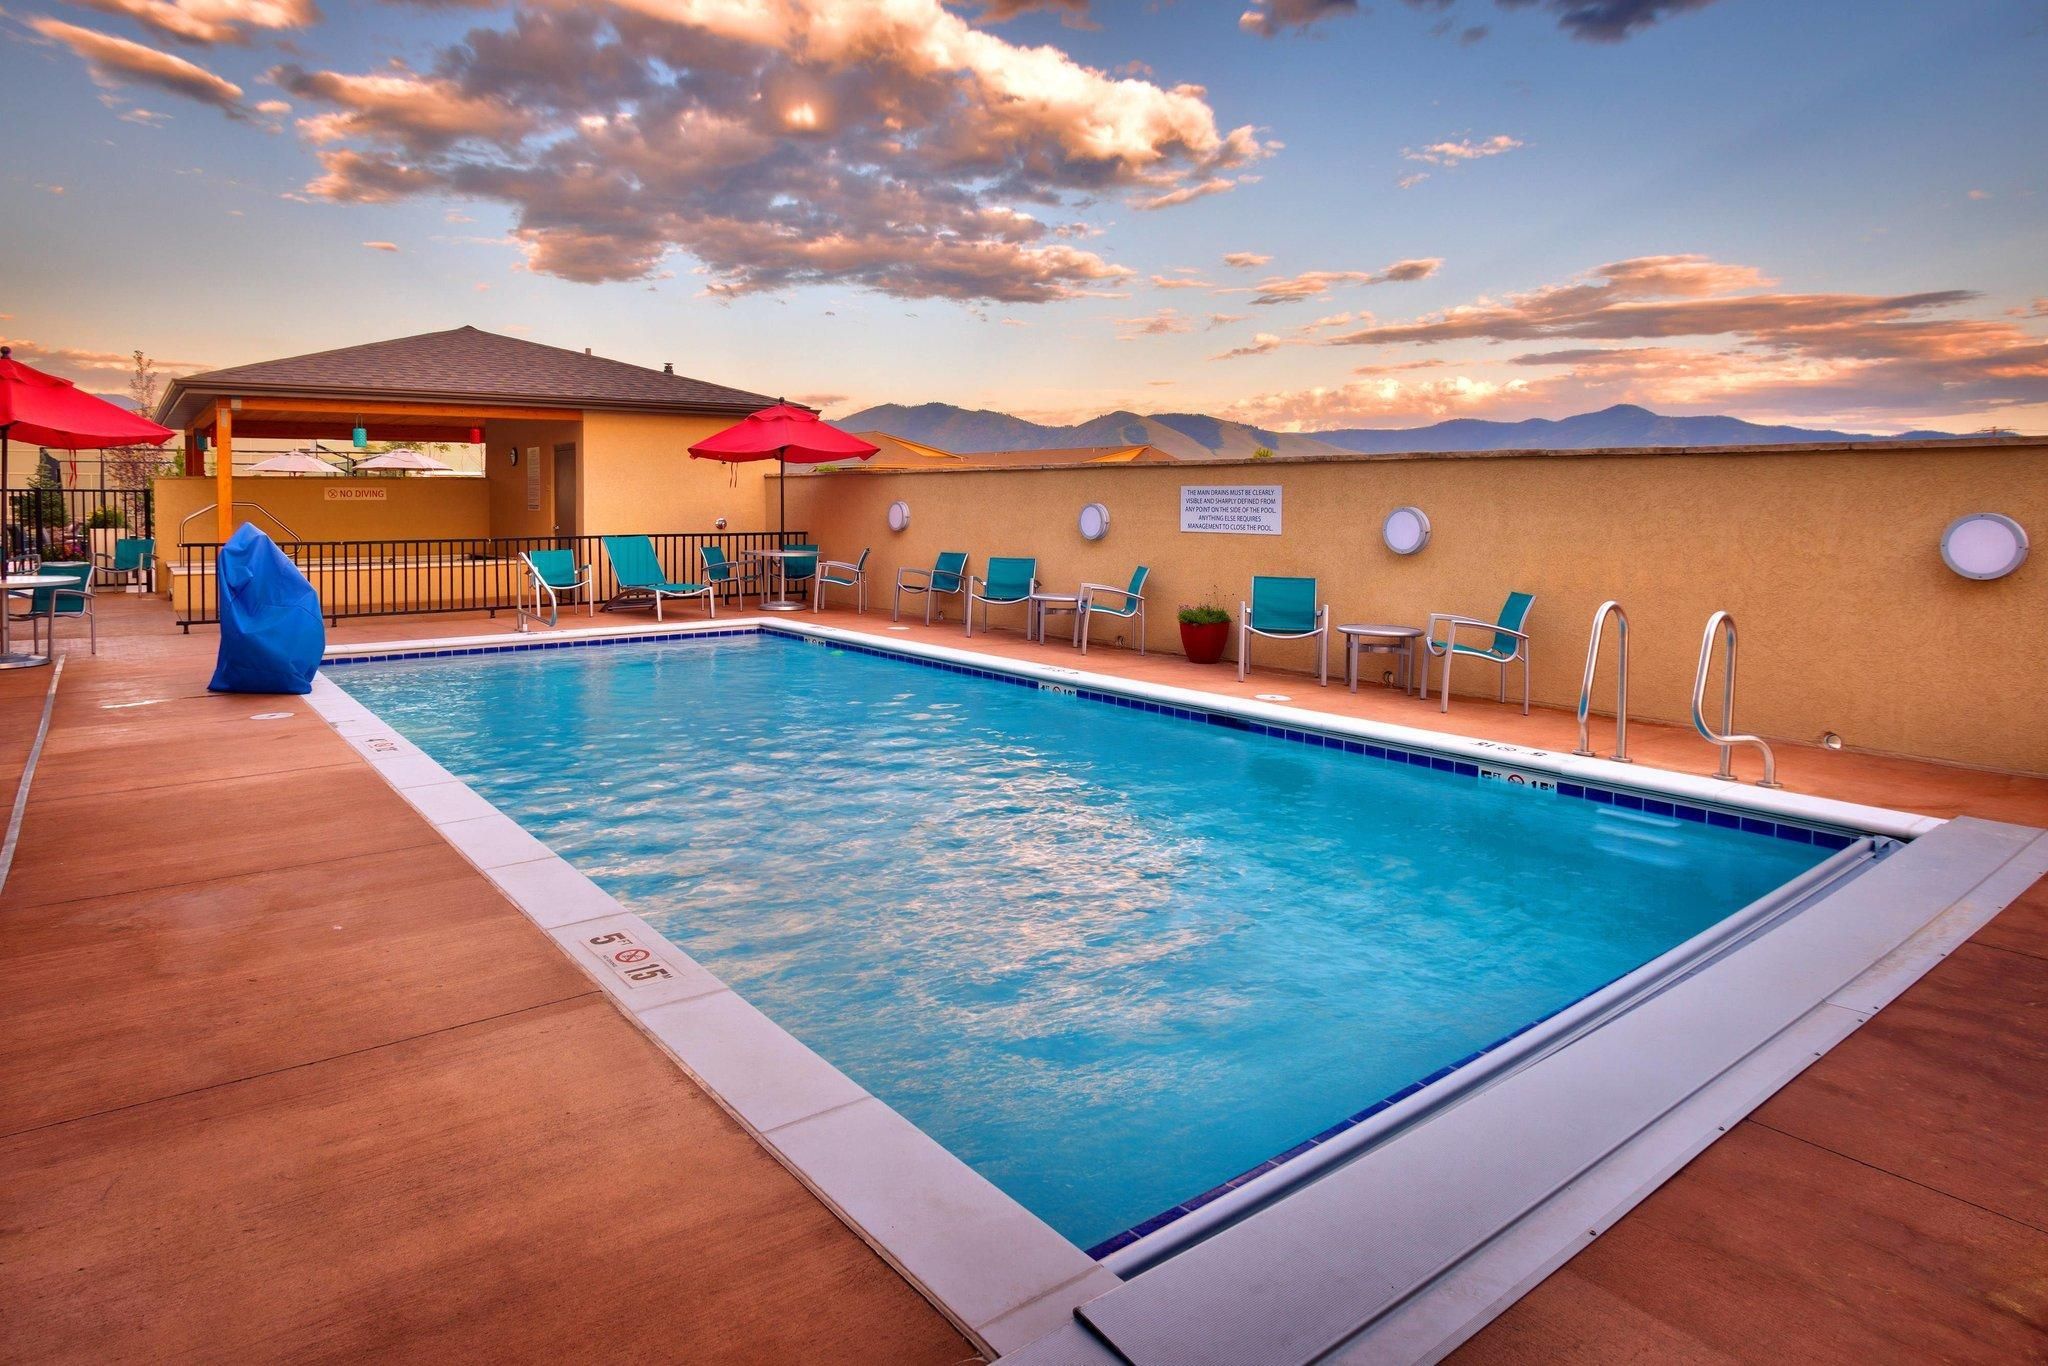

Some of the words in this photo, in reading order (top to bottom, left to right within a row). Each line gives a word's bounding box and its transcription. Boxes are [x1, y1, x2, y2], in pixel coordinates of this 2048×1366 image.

[340, 489, 353, 498] NO
[355, 489, 384, 498] DIVING
[1219, 506, 1229, 514] THE
[1229, 506, 1241, 514] SIDE
[1237, 515, 1262, 523] REQUIRES
